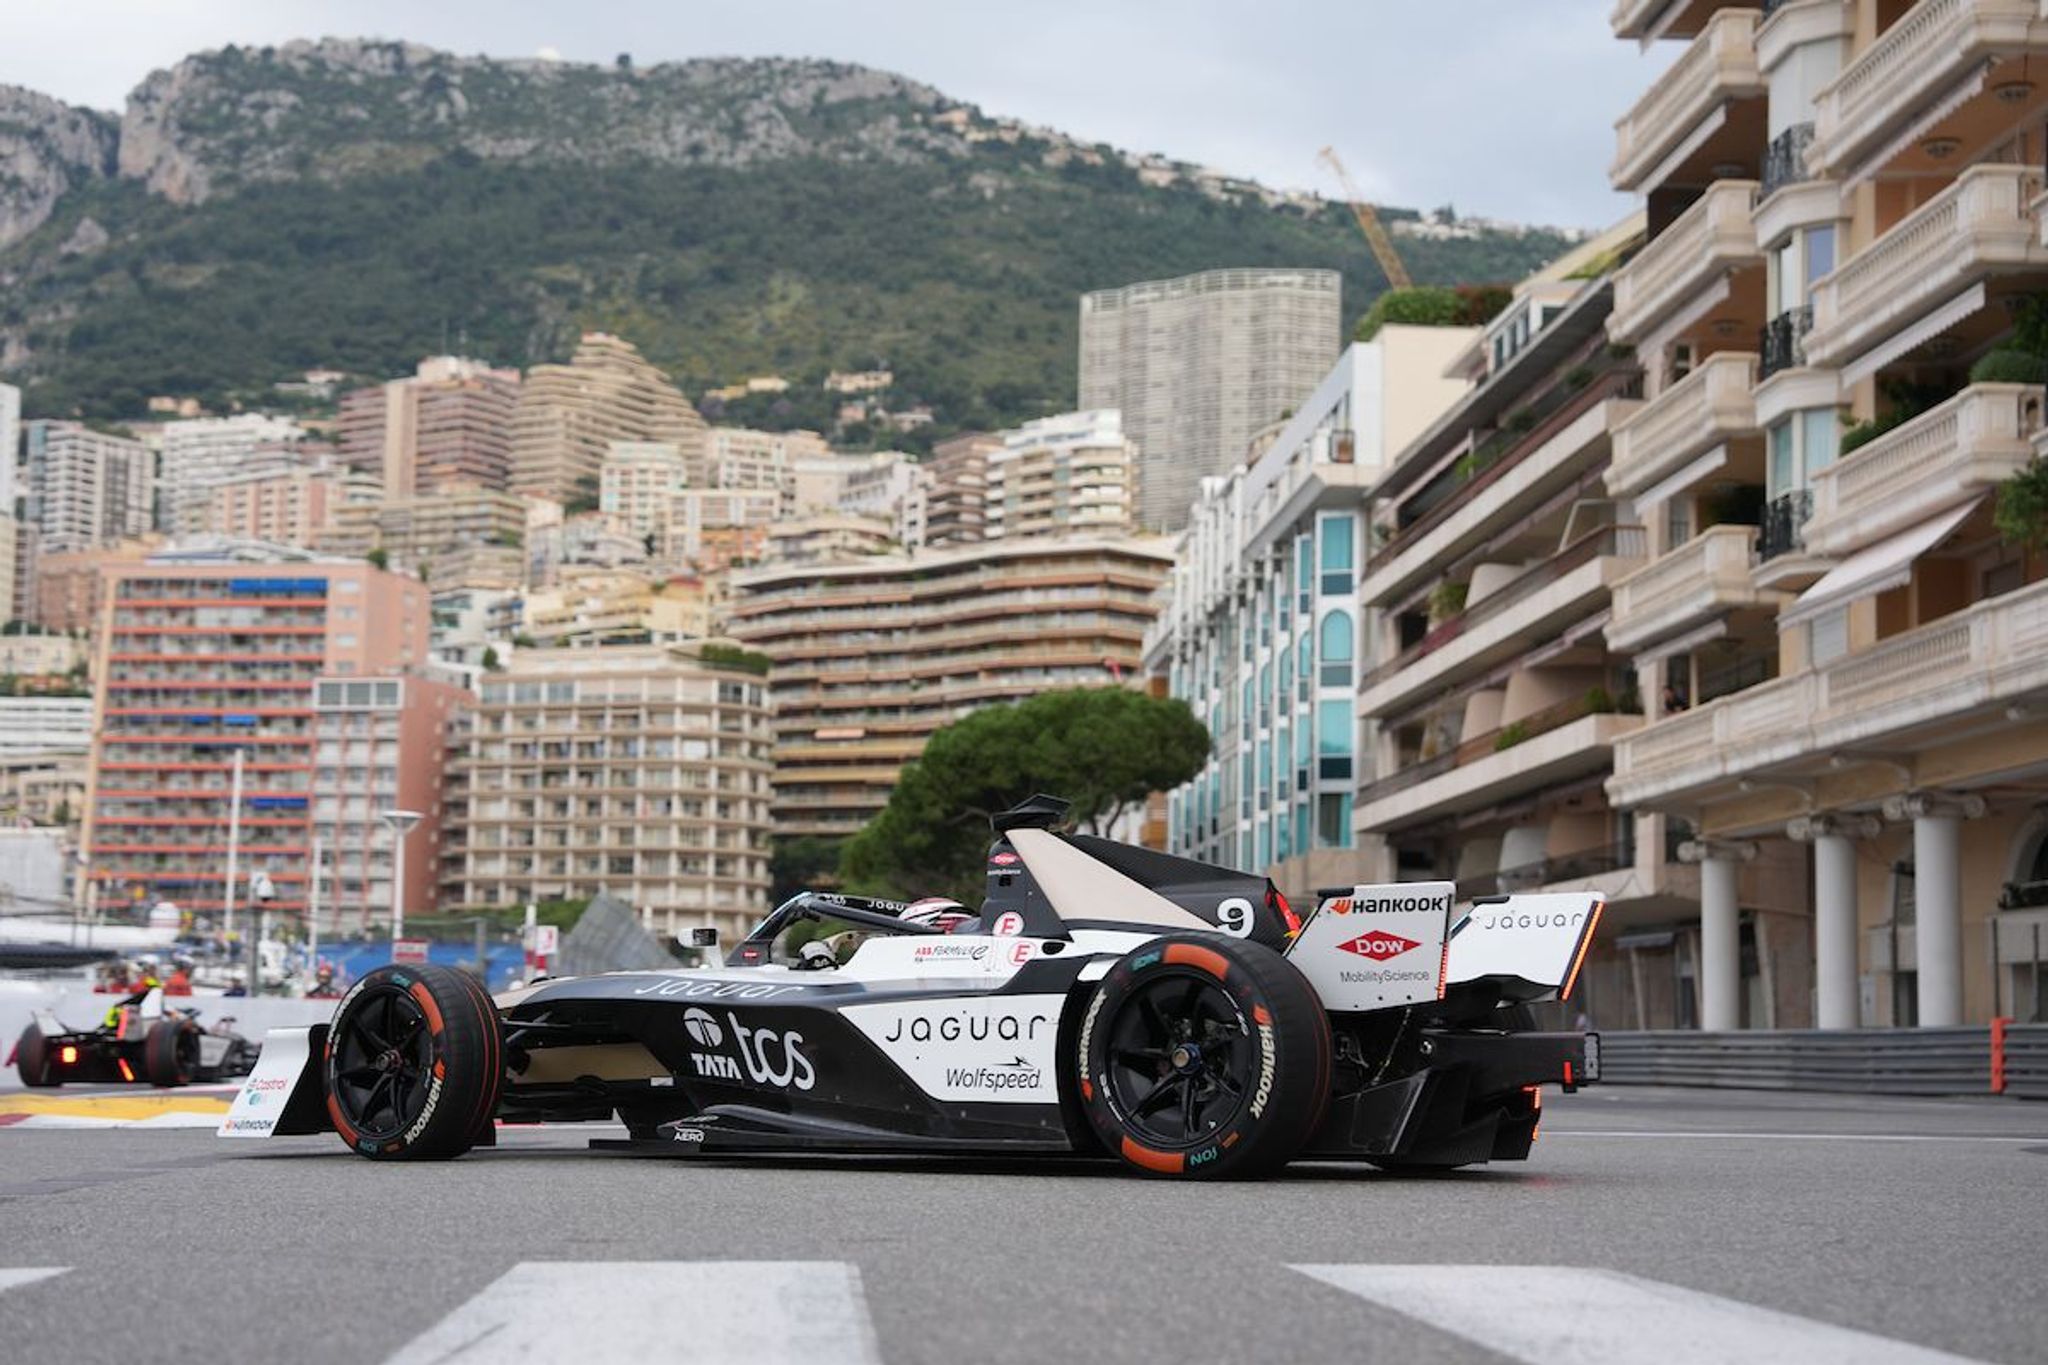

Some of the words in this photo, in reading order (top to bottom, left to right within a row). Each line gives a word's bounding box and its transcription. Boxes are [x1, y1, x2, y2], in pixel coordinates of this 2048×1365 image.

[1000, 918, 1016, 935] E
[1216, 897, 1254, 939] 9
[915, 946, 932, 956] ABB
[1013, 944, 1031, 962] E
[1340, 970, 1429, 984] MobilityScience
[727, 1011, 816, 1090] tcs
[690, 1053, 743, 1080] TATA
[946, 1067, 1042, 1093] Wolfspeed
[673, 1131, 705, 1142] AERO
